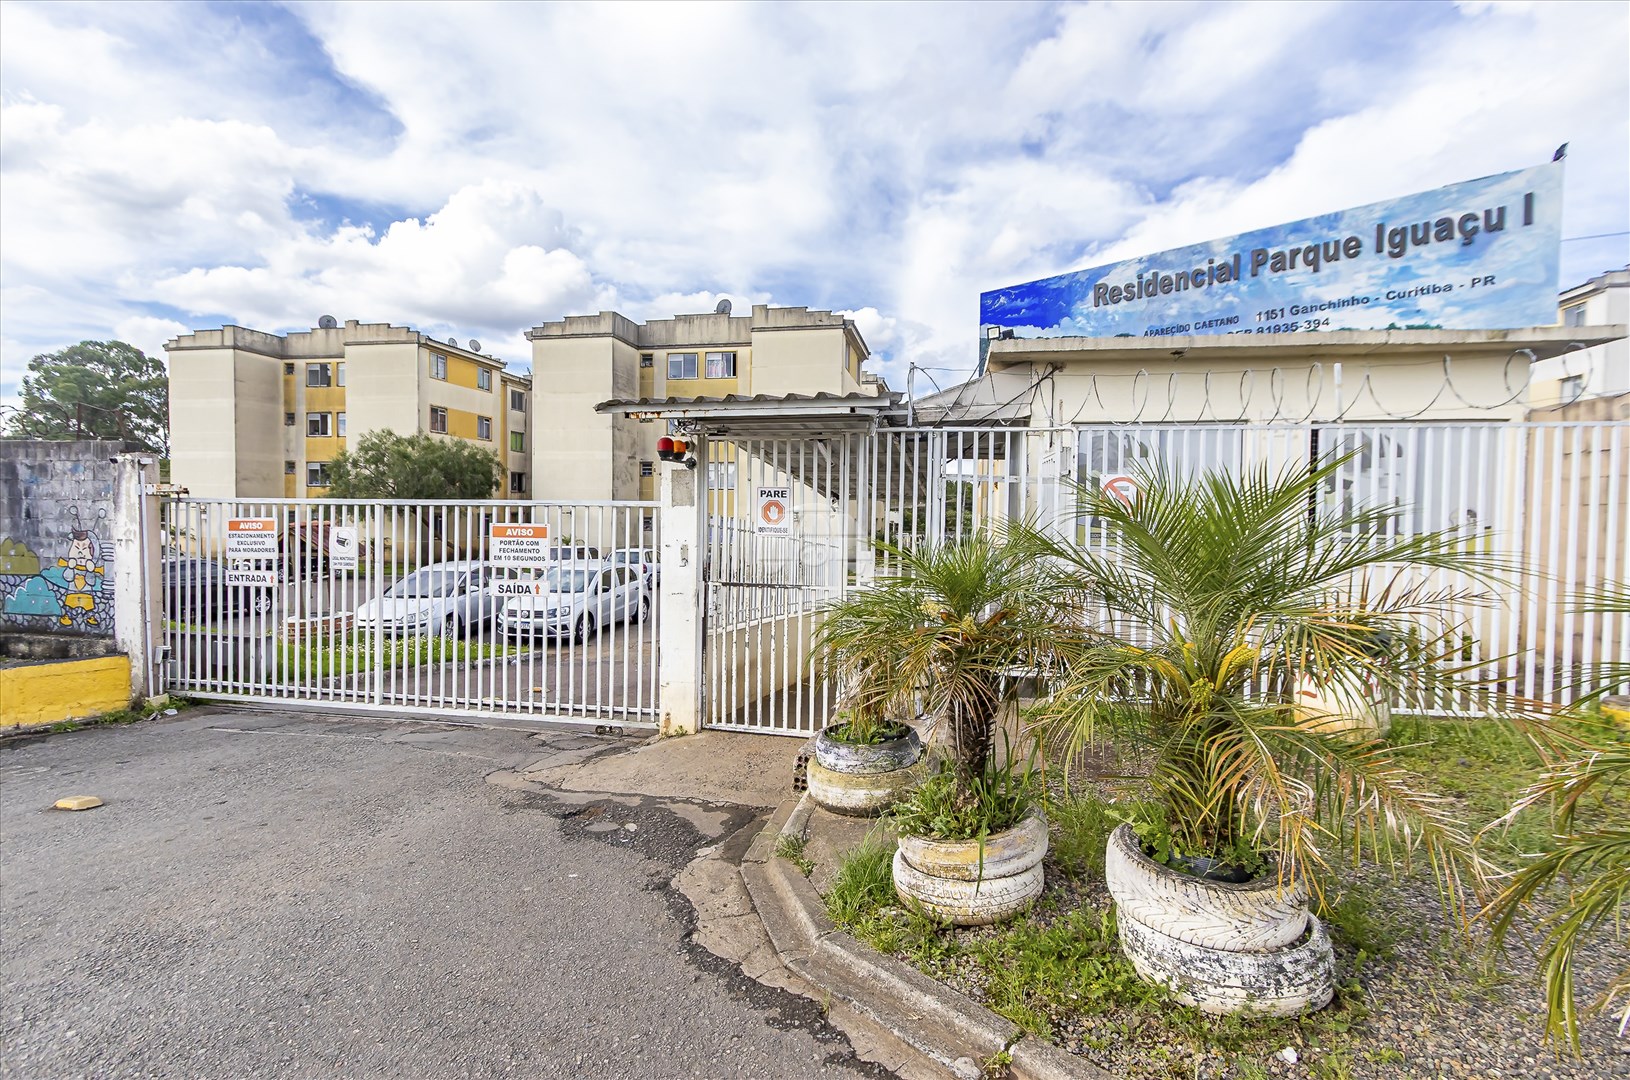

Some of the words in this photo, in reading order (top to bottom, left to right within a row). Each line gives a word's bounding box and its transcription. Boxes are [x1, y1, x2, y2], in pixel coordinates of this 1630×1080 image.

[1093, 253, 1241, 307] Residencial
[1250, 235, 1362, 277] Parque
[1374, 205, 1506, 258] Iguaçu
[1256, 308, 1285, 323] 1151
[1290, 294, 1370, 316] Ganchinho
[1386, 282, 1453, 300] Curitiba
[1471, 275, 1496, 288] PR
[1194, 315, 1240, 330] CAETANO
[760, 490, 787, 498] PARE
[506, 528, 534, 536] AVISO
[228, 574, 267, 582] ENTRADA
[498, 582, 532, 594] SAÍDA
